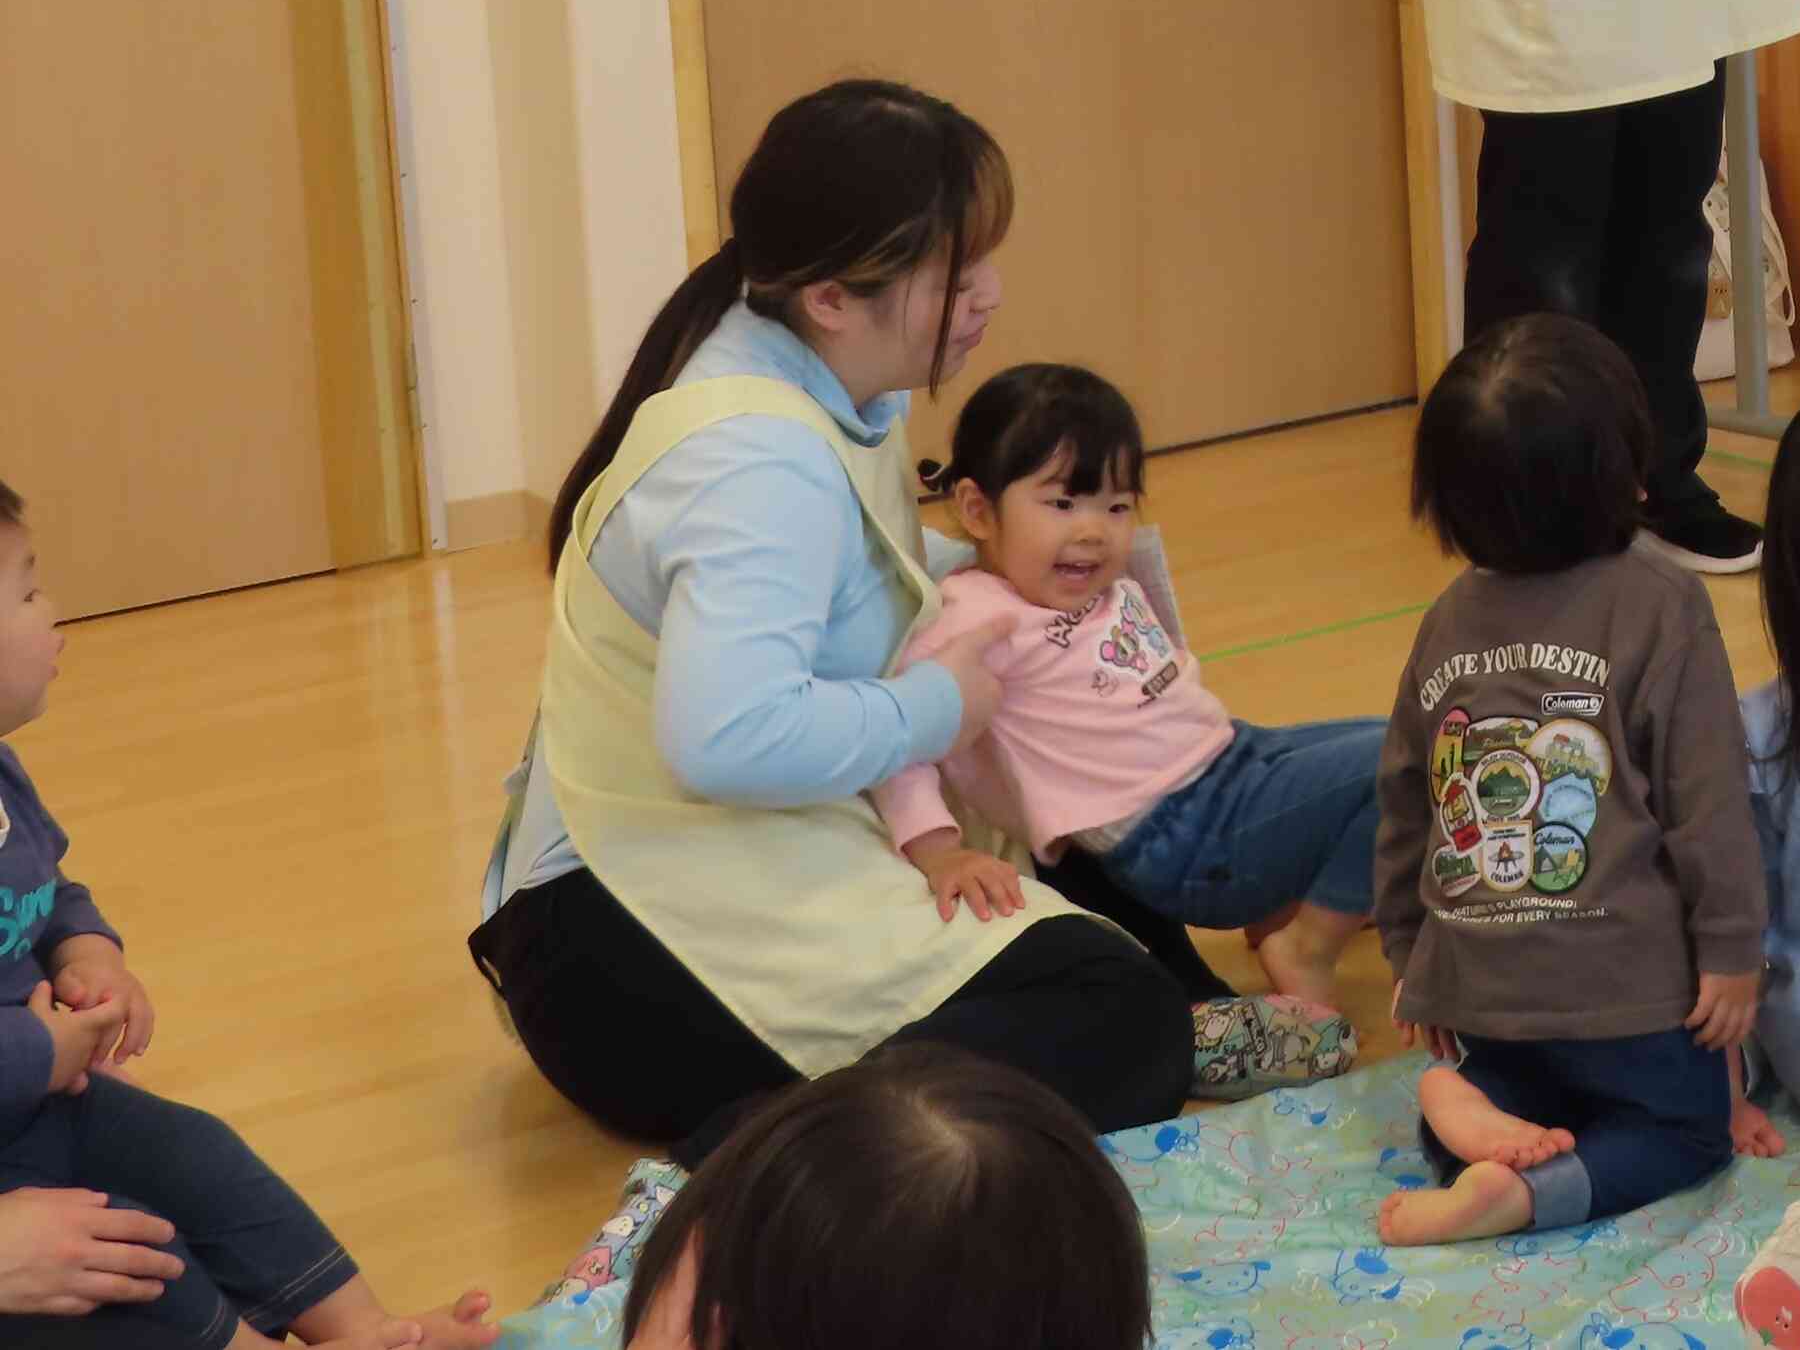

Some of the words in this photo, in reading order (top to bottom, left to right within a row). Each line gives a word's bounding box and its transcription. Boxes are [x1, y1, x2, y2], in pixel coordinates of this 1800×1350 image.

[1419, 652, 1479, 712] CREATE
[1482, 642, 1528, 675] YOUR
[1530, 642, 1610, 691] DESTIN
[1543, 697, 1589, 710] Coleman
